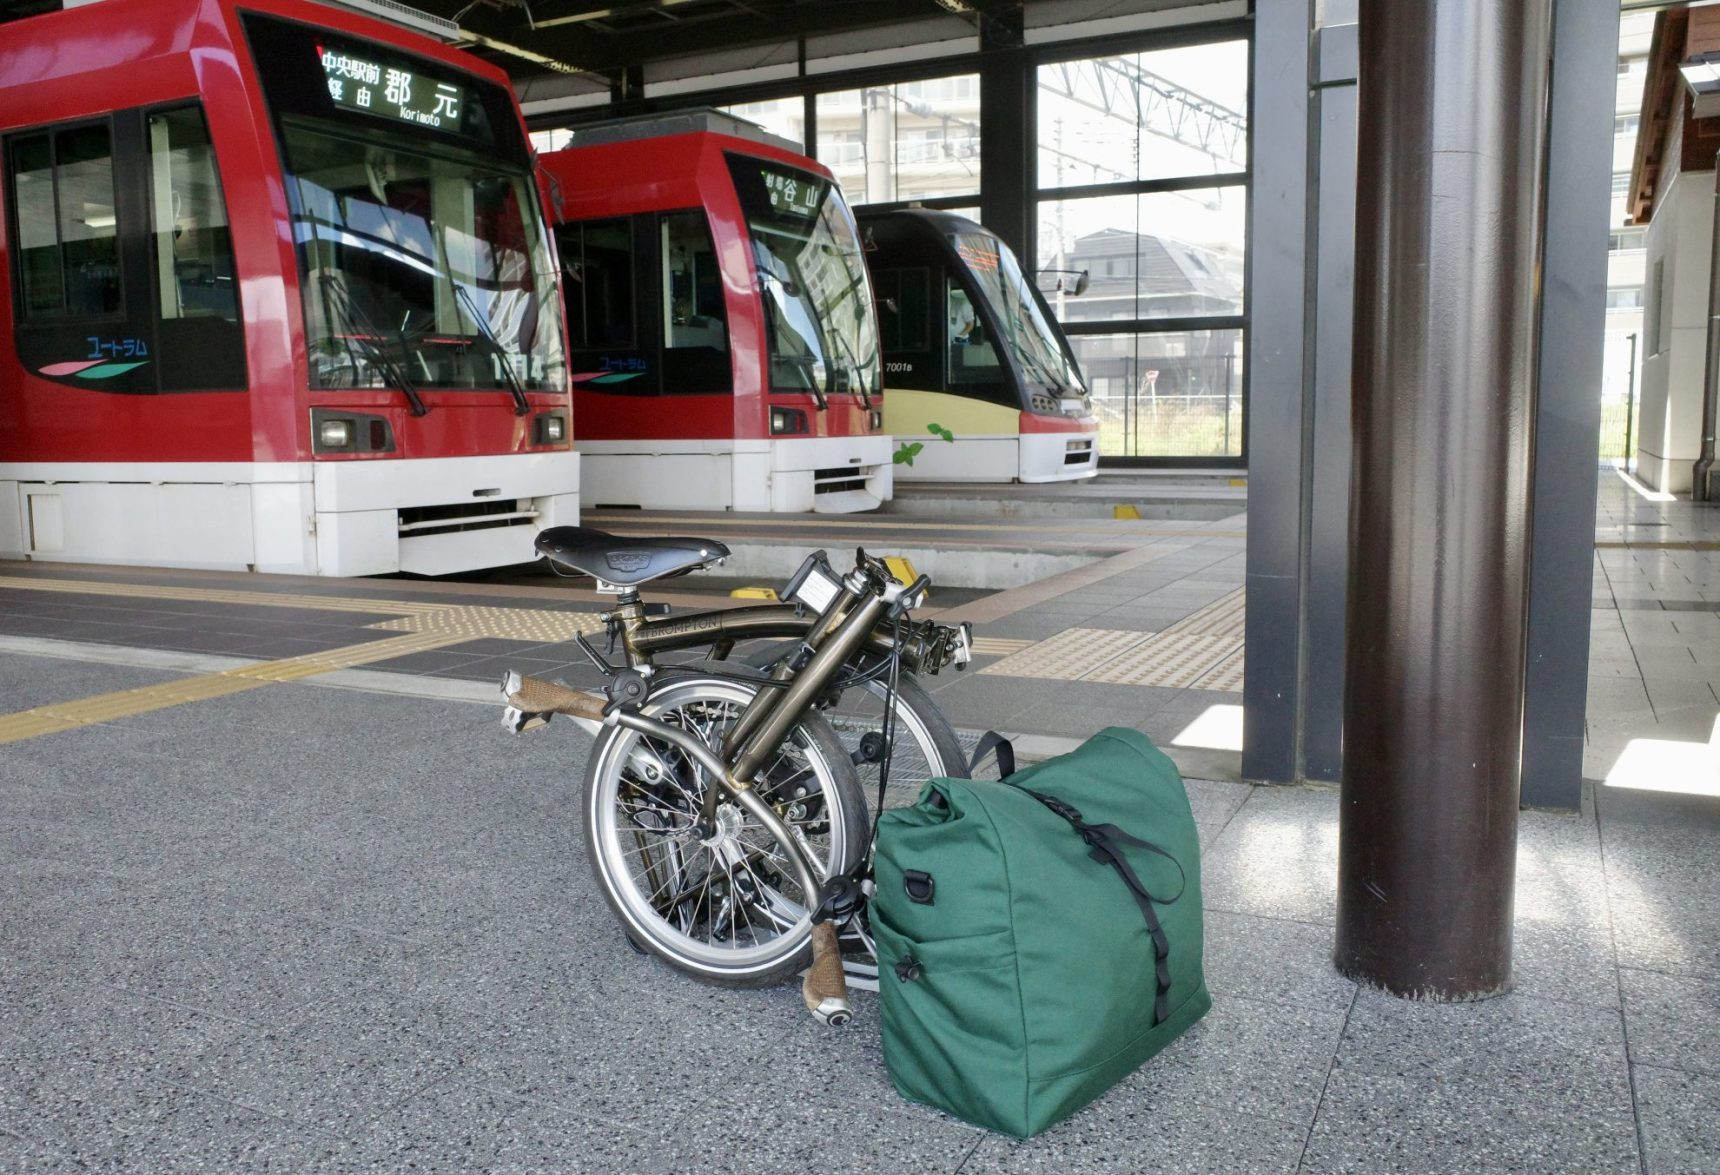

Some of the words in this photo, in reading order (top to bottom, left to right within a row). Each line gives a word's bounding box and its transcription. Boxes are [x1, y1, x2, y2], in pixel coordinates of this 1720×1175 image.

[322, 52, 380, 85] 中央駅前
[400, 106, 440, 126] Korimoto
[87, 336, 147, 358] ユートラム
[651, 618, 718, 637] BROMPTON
